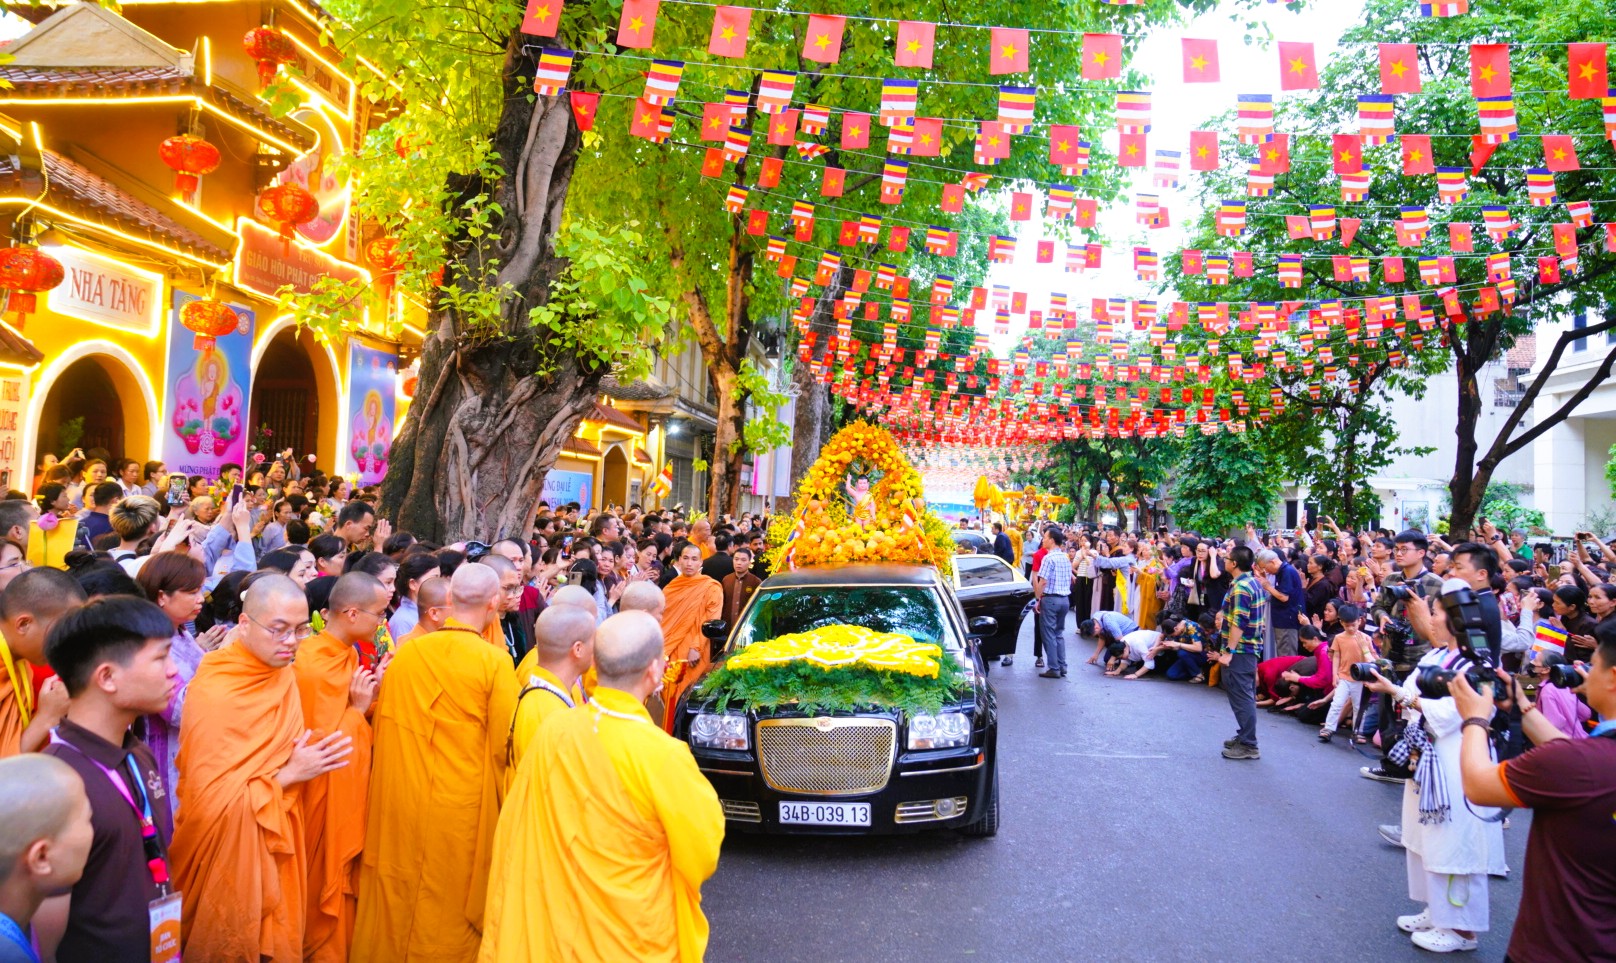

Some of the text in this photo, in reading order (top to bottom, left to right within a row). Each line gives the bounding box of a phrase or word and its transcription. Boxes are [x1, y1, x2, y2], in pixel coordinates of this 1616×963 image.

[246, 250, 268, 272] GIÁO
[270, 257, 288, 280] HỘI
[287, 265, 307, 288] PHẬT
[110, 278, 146, 316] TĂNG
[782, 804, 868, 823] 34B-039.13
